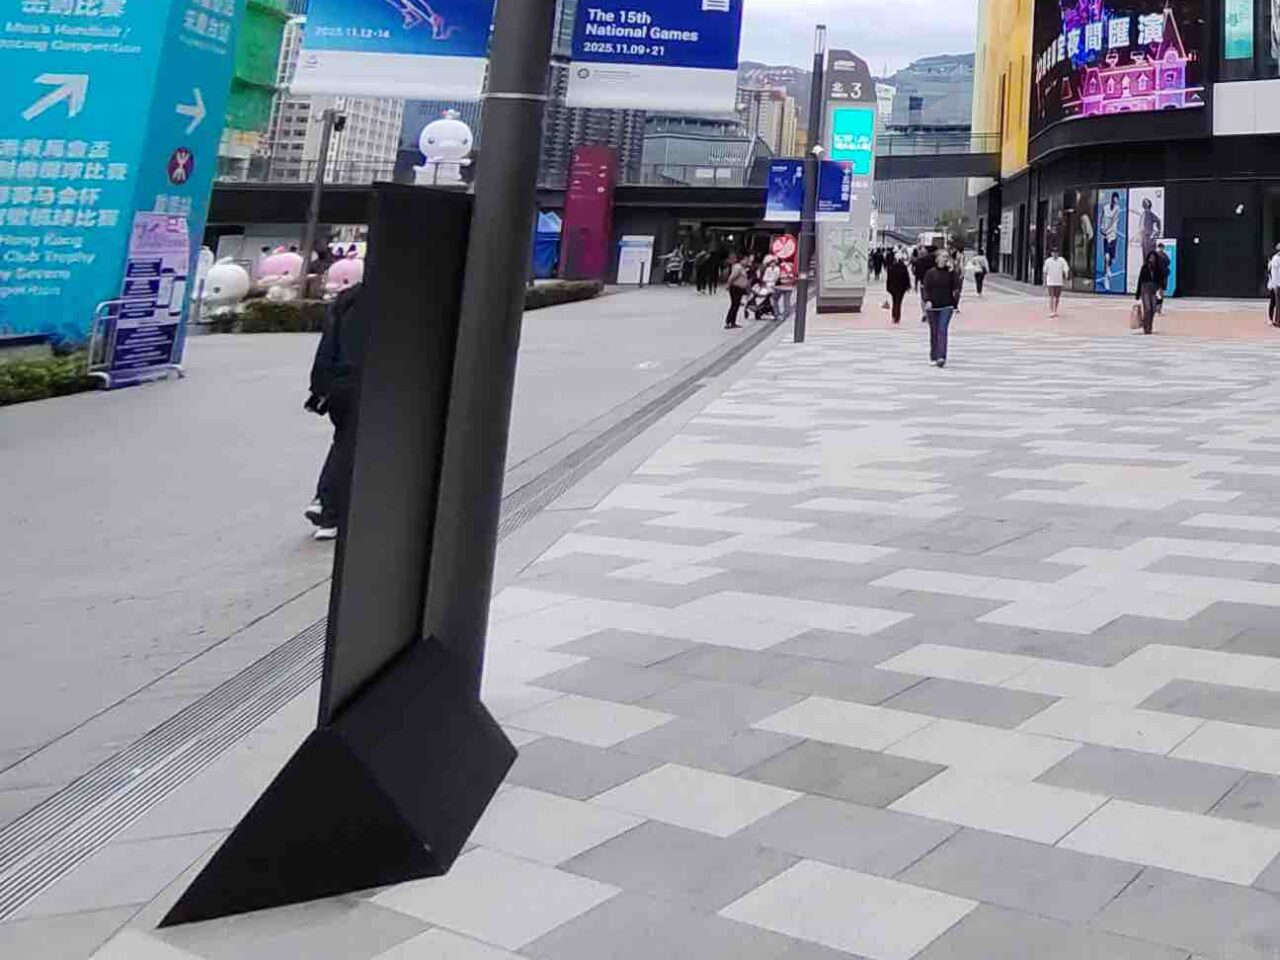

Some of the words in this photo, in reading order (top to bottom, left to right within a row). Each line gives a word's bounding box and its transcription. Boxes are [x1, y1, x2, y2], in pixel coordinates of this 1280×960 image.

[588, 8, 615, 22] The
[619, 10, 652, 25] 15th
[585, 23, 647, 38] National
[650, 26, 699, 41] Games
[850, 82, 862, 99] 3
